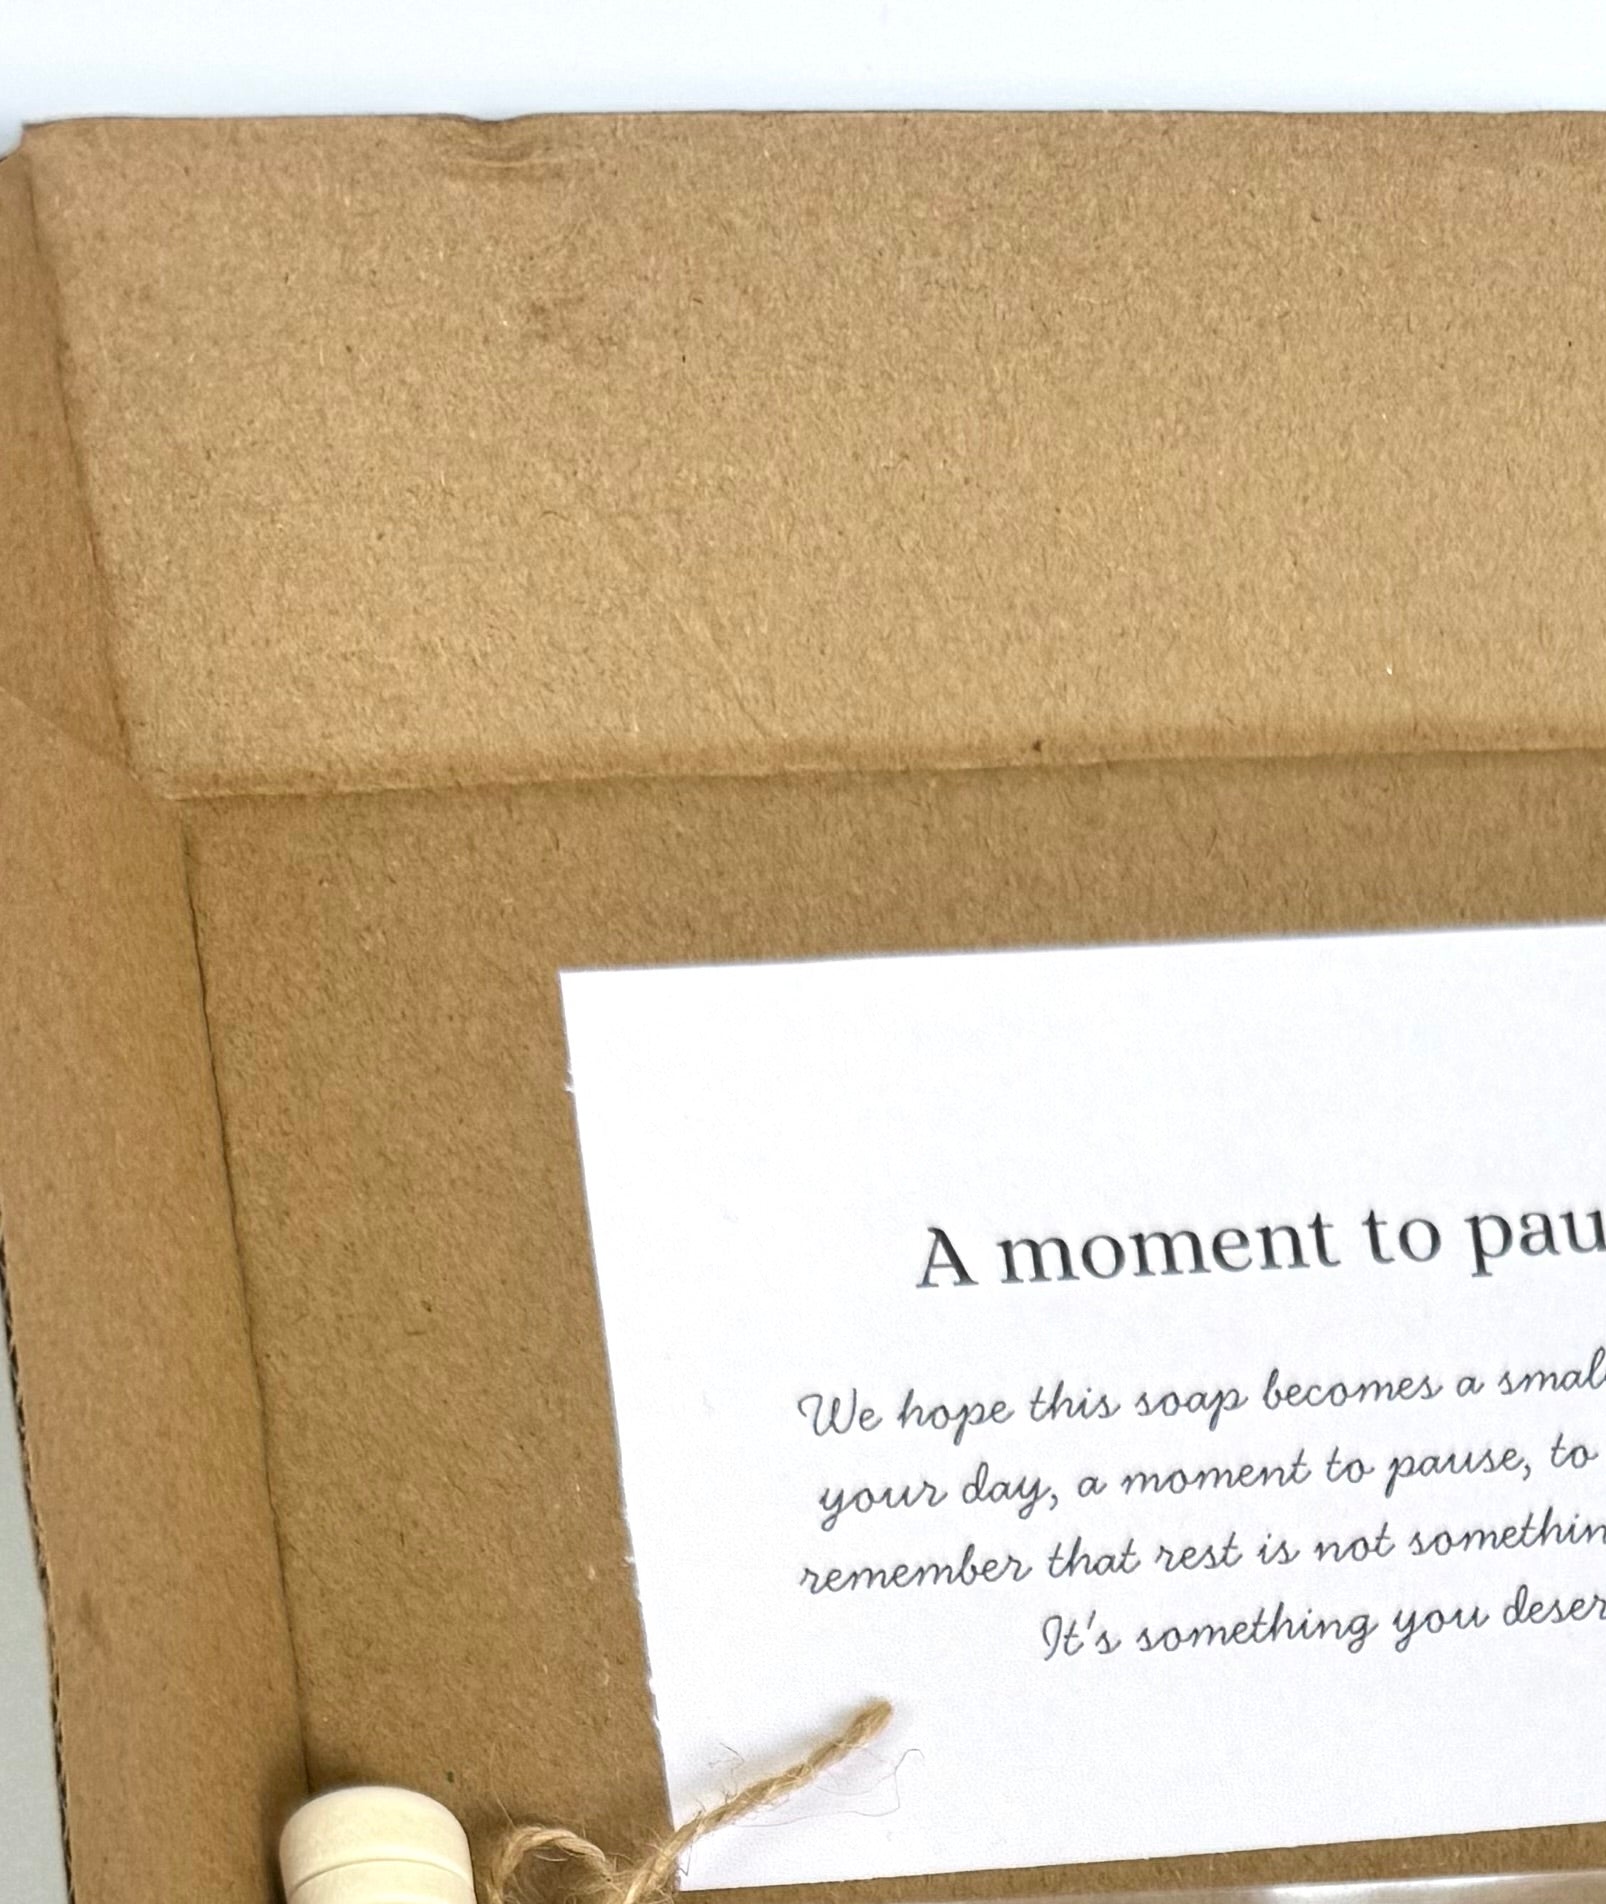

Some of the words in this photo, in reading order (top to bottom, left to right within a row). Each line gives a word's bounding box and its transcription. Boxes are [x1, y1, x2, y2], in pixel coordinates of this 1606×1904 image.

[916, 1226, 979, 1288] A
[996, 1212, 1341, 1284] moment
[1362, 1209, 1441, 1264] to
[797, 1388, 883, 1436] We
[897, 1388, 1015, 1446] hope
[1030, 1380, 1121, 1422] this
[1135, 1388, 1248, 1431] soap
[1262, 1367, 1443, 1410] becomes
[1456, 1376, 1485, 1397] a
[819, 1480, 948, 1532] your
[962, 1461, 1058, 1520] day,
[1077, 1476, 1107, 1497] a
[1120, 1448, 1312, 1495] moment
[1326, 1446, 1375, 1483] to
[1384, 1448, 1531, 1499] pause,
[1551, 1432, 1599, 1469] to
[799, 1543, 1033, 1594] remember
[1048, 1536, 1141, 1578] that
[1154, 1531, 1243, 1572] rest
[1257, 1533, 1300, 1565] is
[1314, 1522, 1395, 1562] not
[1042, 1609, 1122, 1661] It's
[1136, 1601, 1379, 1654] something
[1392, 1606, 1490, 1653] you
